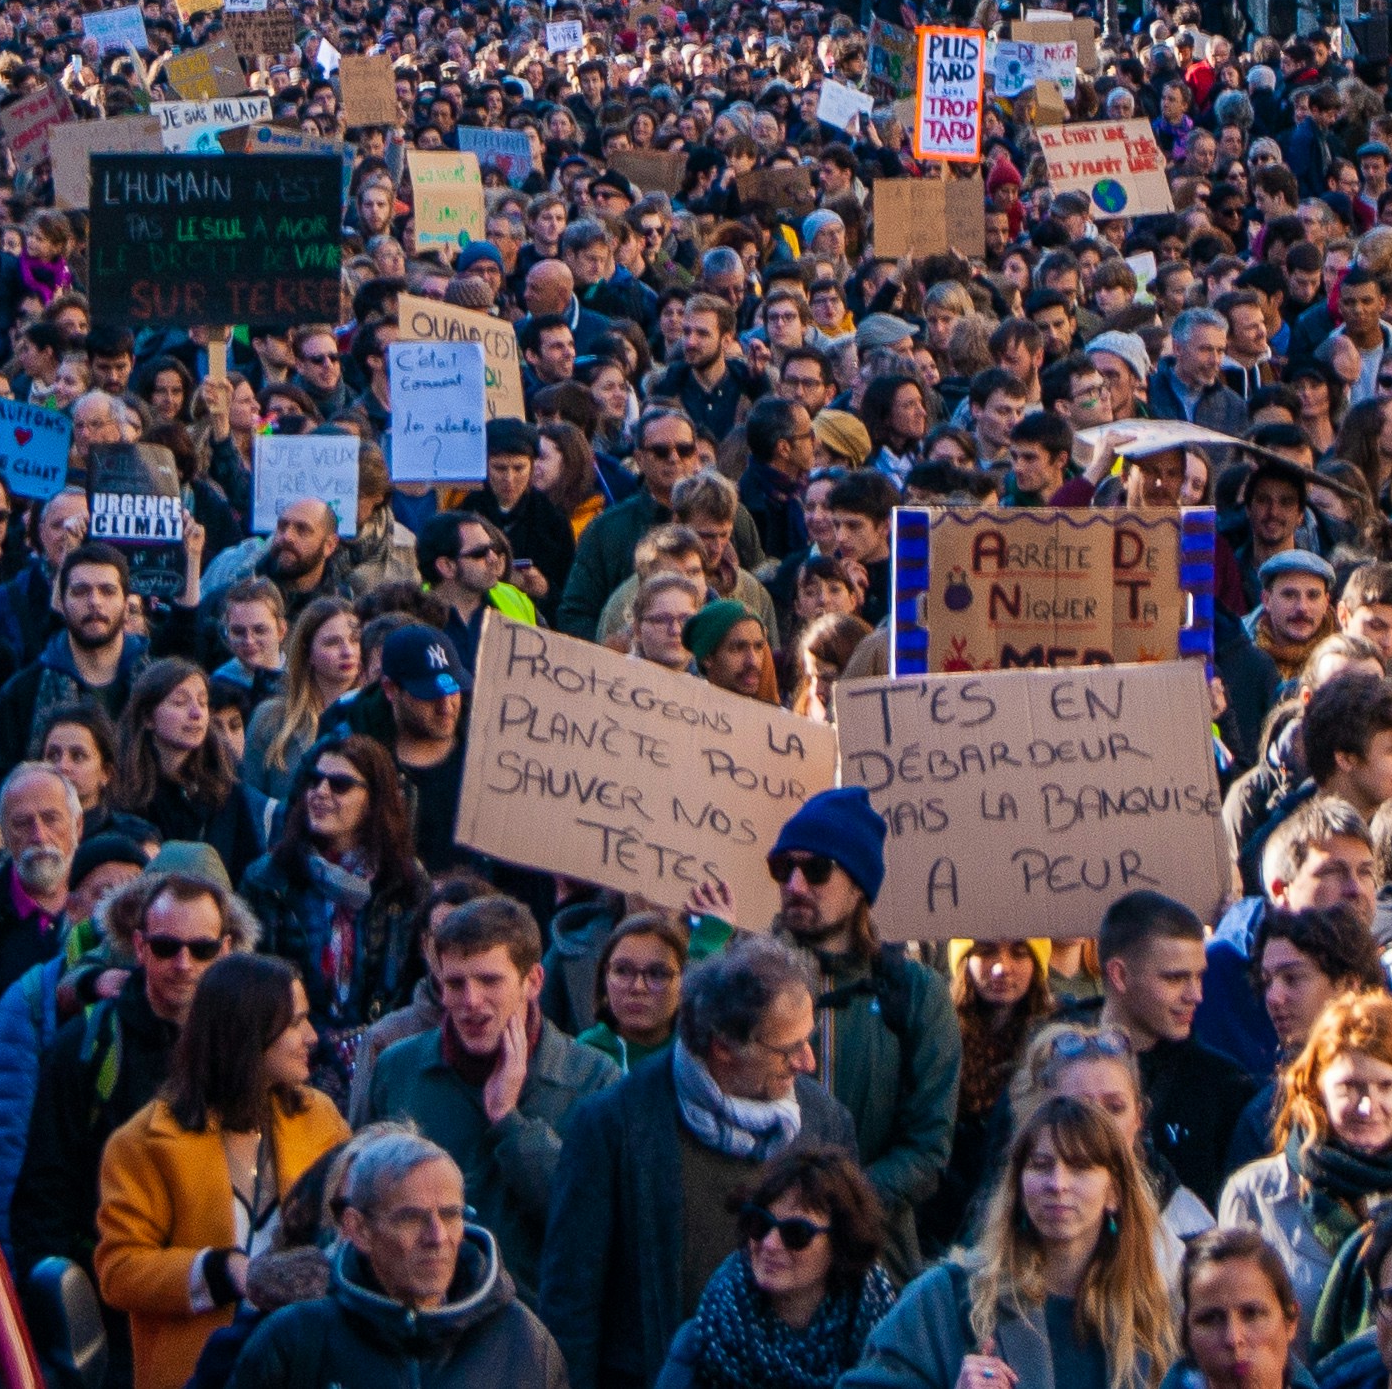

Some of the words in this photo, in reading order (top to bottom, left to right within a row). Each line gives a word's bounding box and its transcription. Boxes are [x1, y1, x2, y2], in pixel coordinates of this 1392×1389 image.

[929, 35, 979, 60] PLUS
[927, 61, 975, 84] TARD
[924, 95, 979, 119] TROP
[923, 119, 975, 146] TARD
[1101, 124, 1127, 142] UNE
[1125, 156, 1158, 174] UNE
[103, 169, 232, 206] L'HUMAIN
[126, 212, 164, 243] PAS
[177, 216, 201, 243] LE
[202, 215, 247, 242] SEUL
[274, 214, 330, 241] AVOIR
[130, 279, 208, 320] SUR
[225, 278, 342, 317] TERRE
[265, 443, 303, 468] JE
[311, 442, 356, 468] VEUX
[93, 492, 182, 515] URGENCE
[94, 515, 181, 537] CLIMAT
[972, 529, 1093, 573] ARRÊTE
[1112, 528, 1160, 573] DE
[1113, 579, 1160, 622] TA
[847, 681, 999, 747] T'ES
[1049, 678, 1125, 722] EN
[498, 692, 672, 769] PLANÈTE
[700, 746, 810, 804] POUR
[767, 722, 805, 760] LA
[847, 730, 1155, 794] DÉBARDEUR
[488, 750, 657, 824] SAUVER
[671, 797, 758, 846] NOS
[979, 791, 1021, 822] LA
[1040, 782, 1222, 834] BANQUISE
[576, 816, 727, 894] TÊTES
[926, 855, 960, 913] A
[1010, 846, 1161, 895] PEUR
